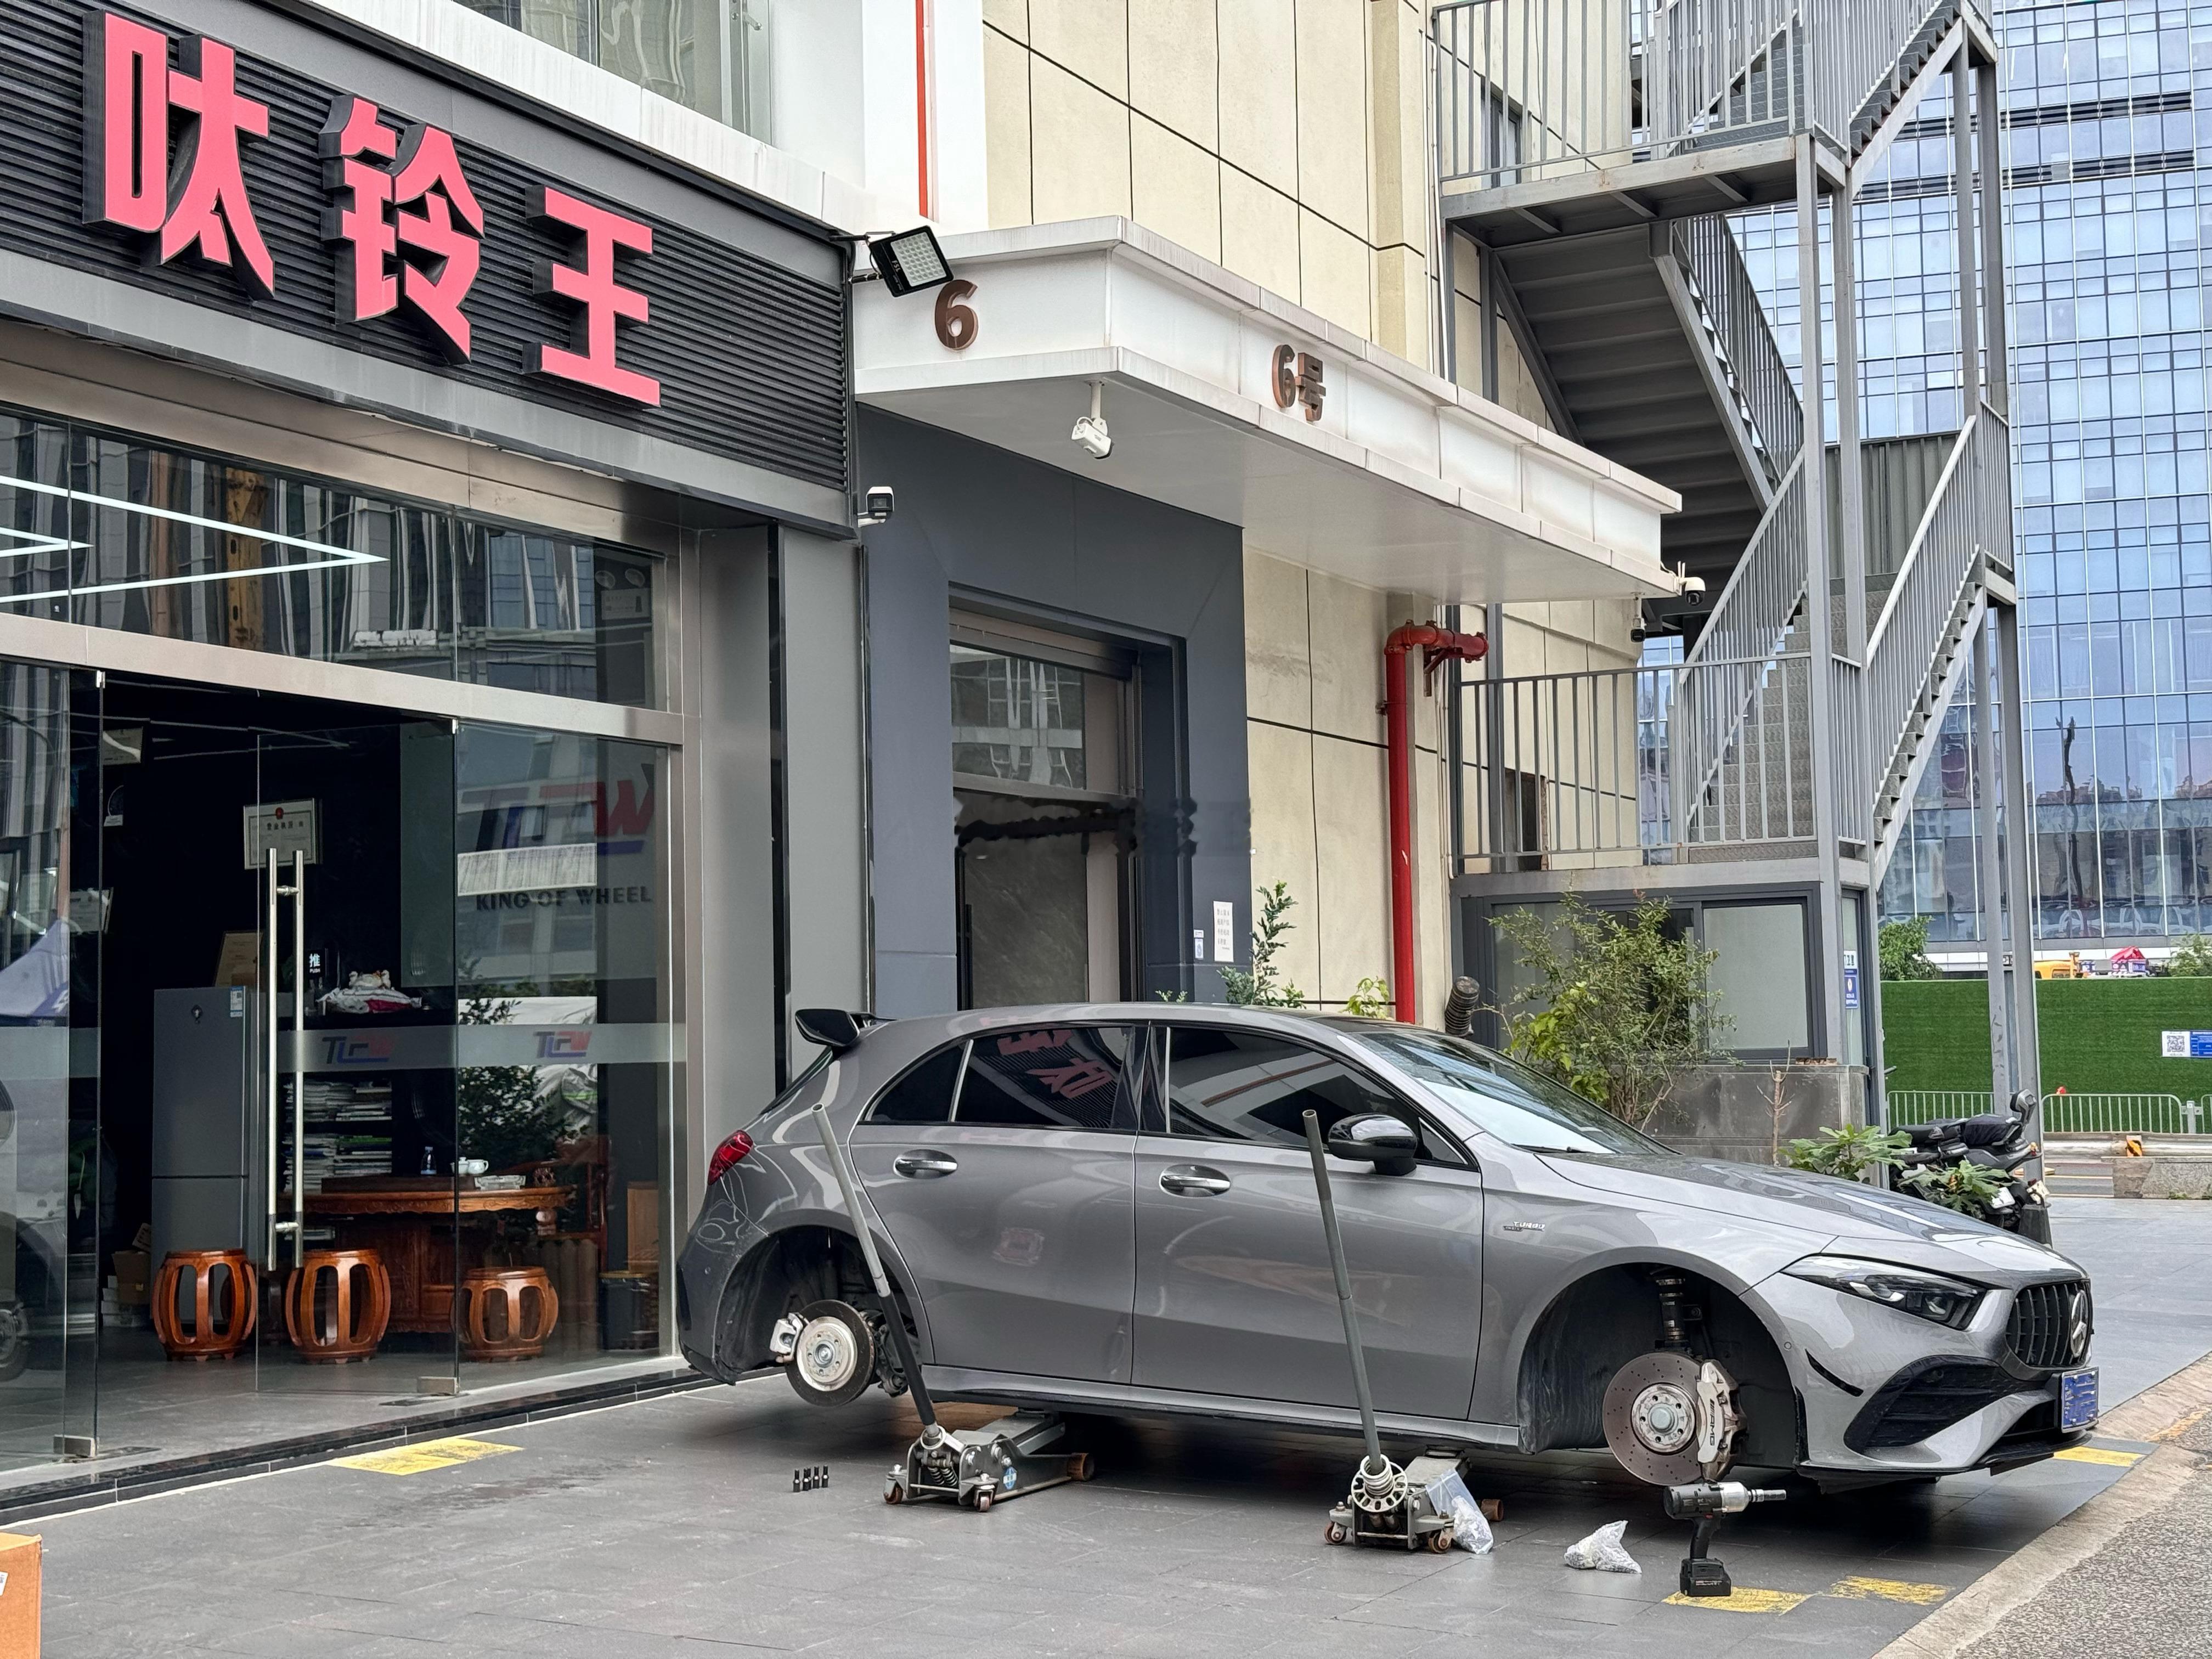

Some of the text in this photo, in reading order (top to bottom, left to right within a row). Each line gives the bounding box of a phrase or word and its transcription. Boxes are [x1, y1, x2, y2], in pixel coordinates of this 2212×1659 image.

[85, 10, 662, 408] 呔铃王
[934, 279, 979, 351] 6
[1272, 344, 1326, 422] 6号
[476, 885, 651, 911] KING OF WHEEL
[309, 953, 321, 968] 推
